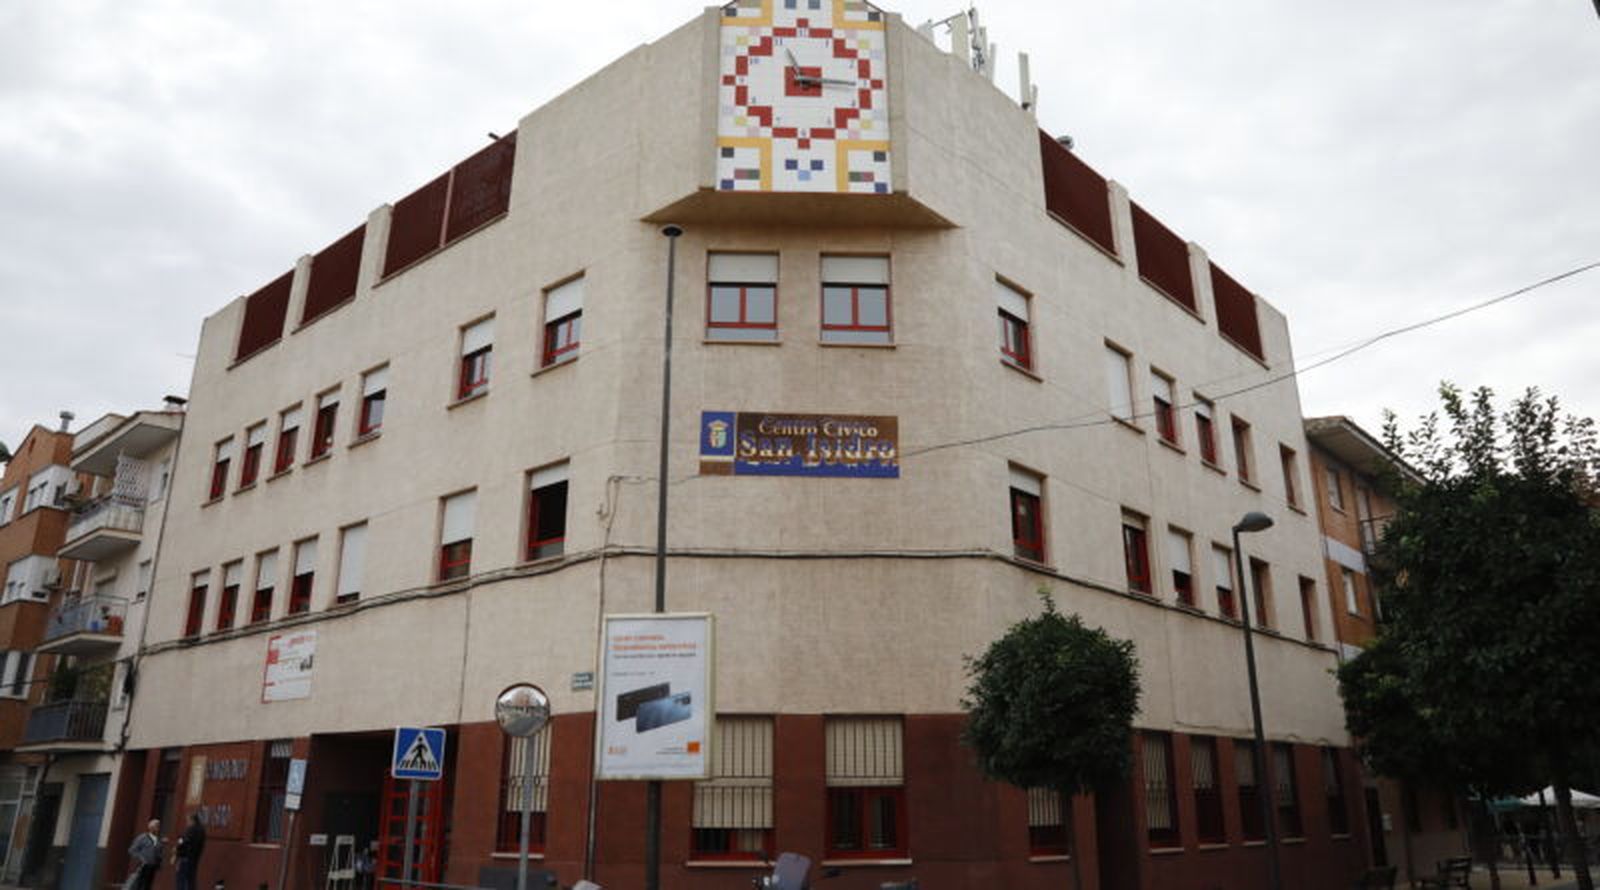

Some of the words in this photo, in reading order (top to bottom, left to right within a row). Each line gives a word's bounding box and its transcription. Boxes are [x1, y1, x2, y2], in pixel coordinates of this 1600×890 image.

[759, 417, 817, 435] Centro
[739, 432, 793, 458] San
[806, 432, 896, 460] Isidro
